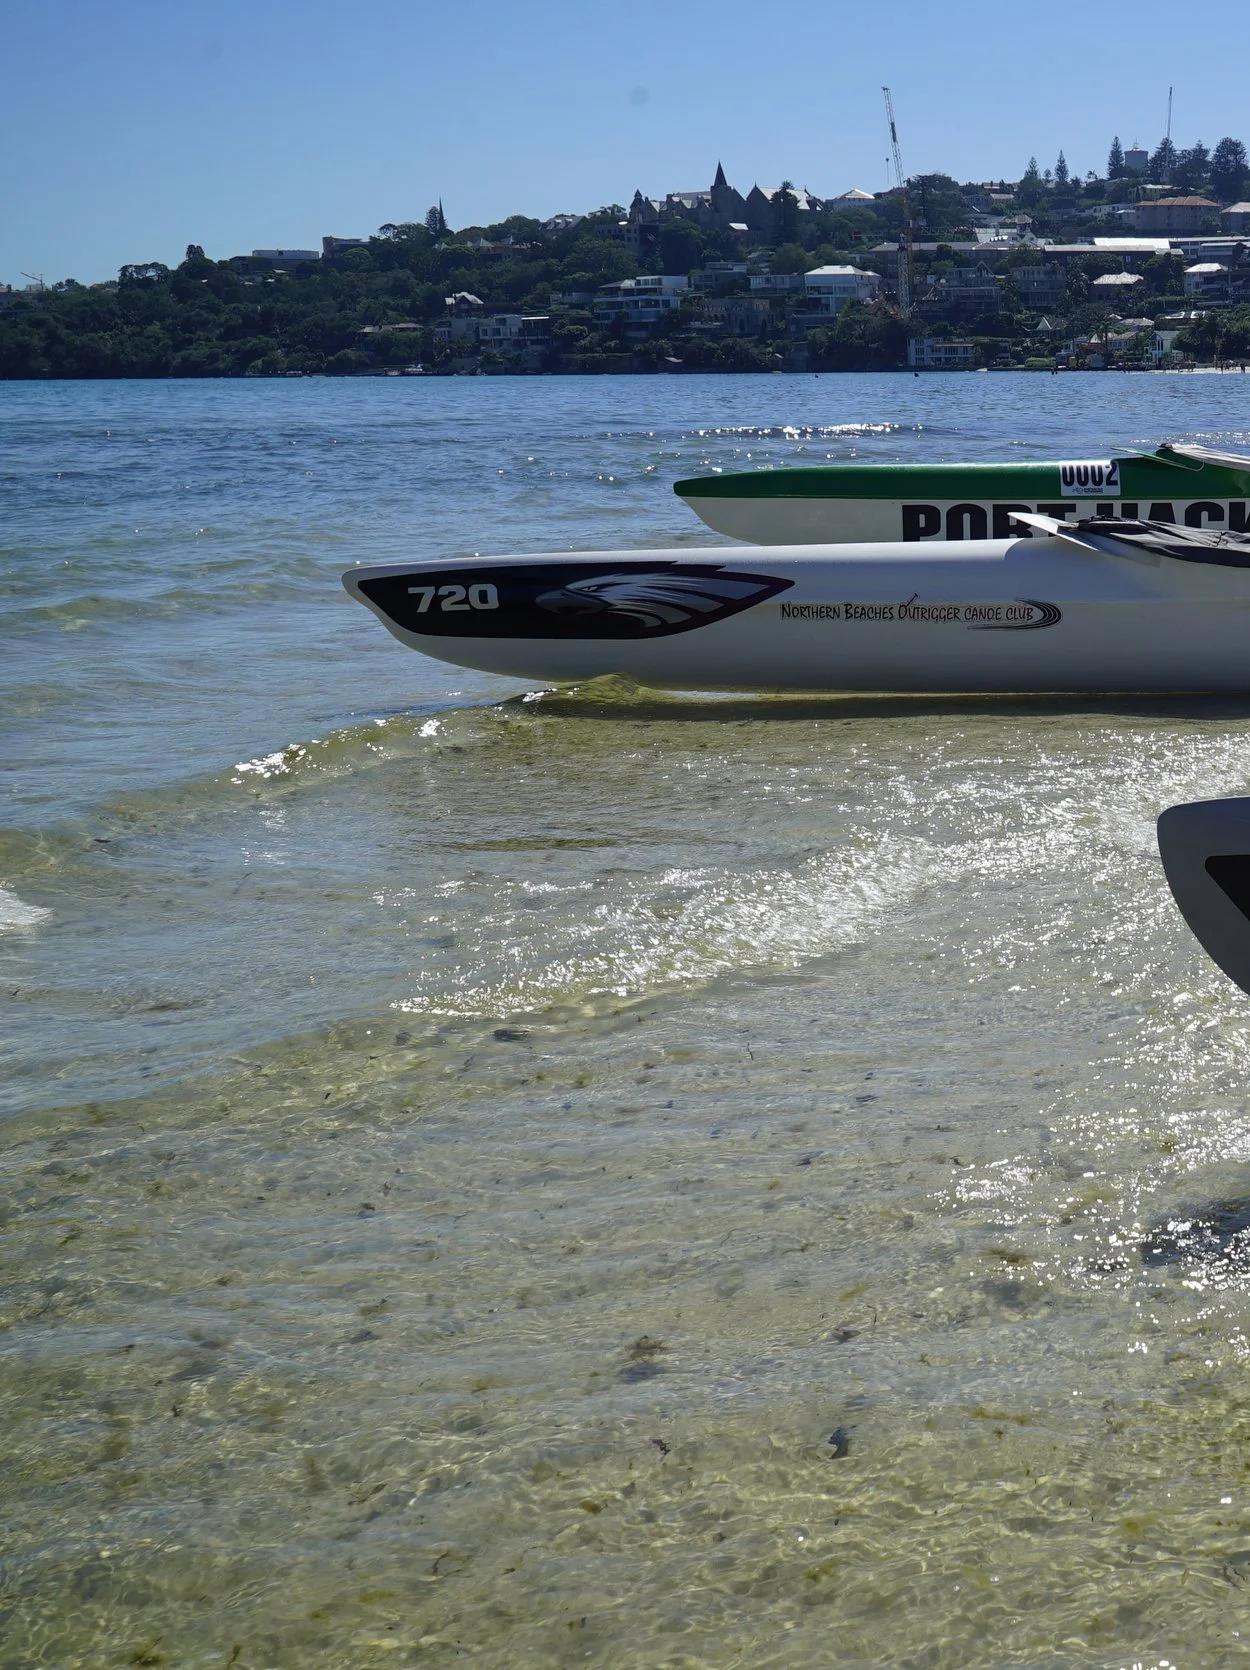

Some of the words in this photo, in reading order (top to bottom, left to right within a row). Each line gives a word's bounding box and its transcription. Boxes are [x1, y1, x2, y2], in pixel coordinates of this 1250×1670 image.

[1061, 460, 1119, 487] 0002
[902, 503, 1077, 542] PORT
[407, 583, 500, 613] 720
[781, 603, 841, 619] NORTHERN
[844, 603, 894, 620] BEACHES
[898, 601, 961, 621] OUTRIGGER
[964, 606, 1001, 620] CANOE
[1005, 606, 1034, 621] CLUB
